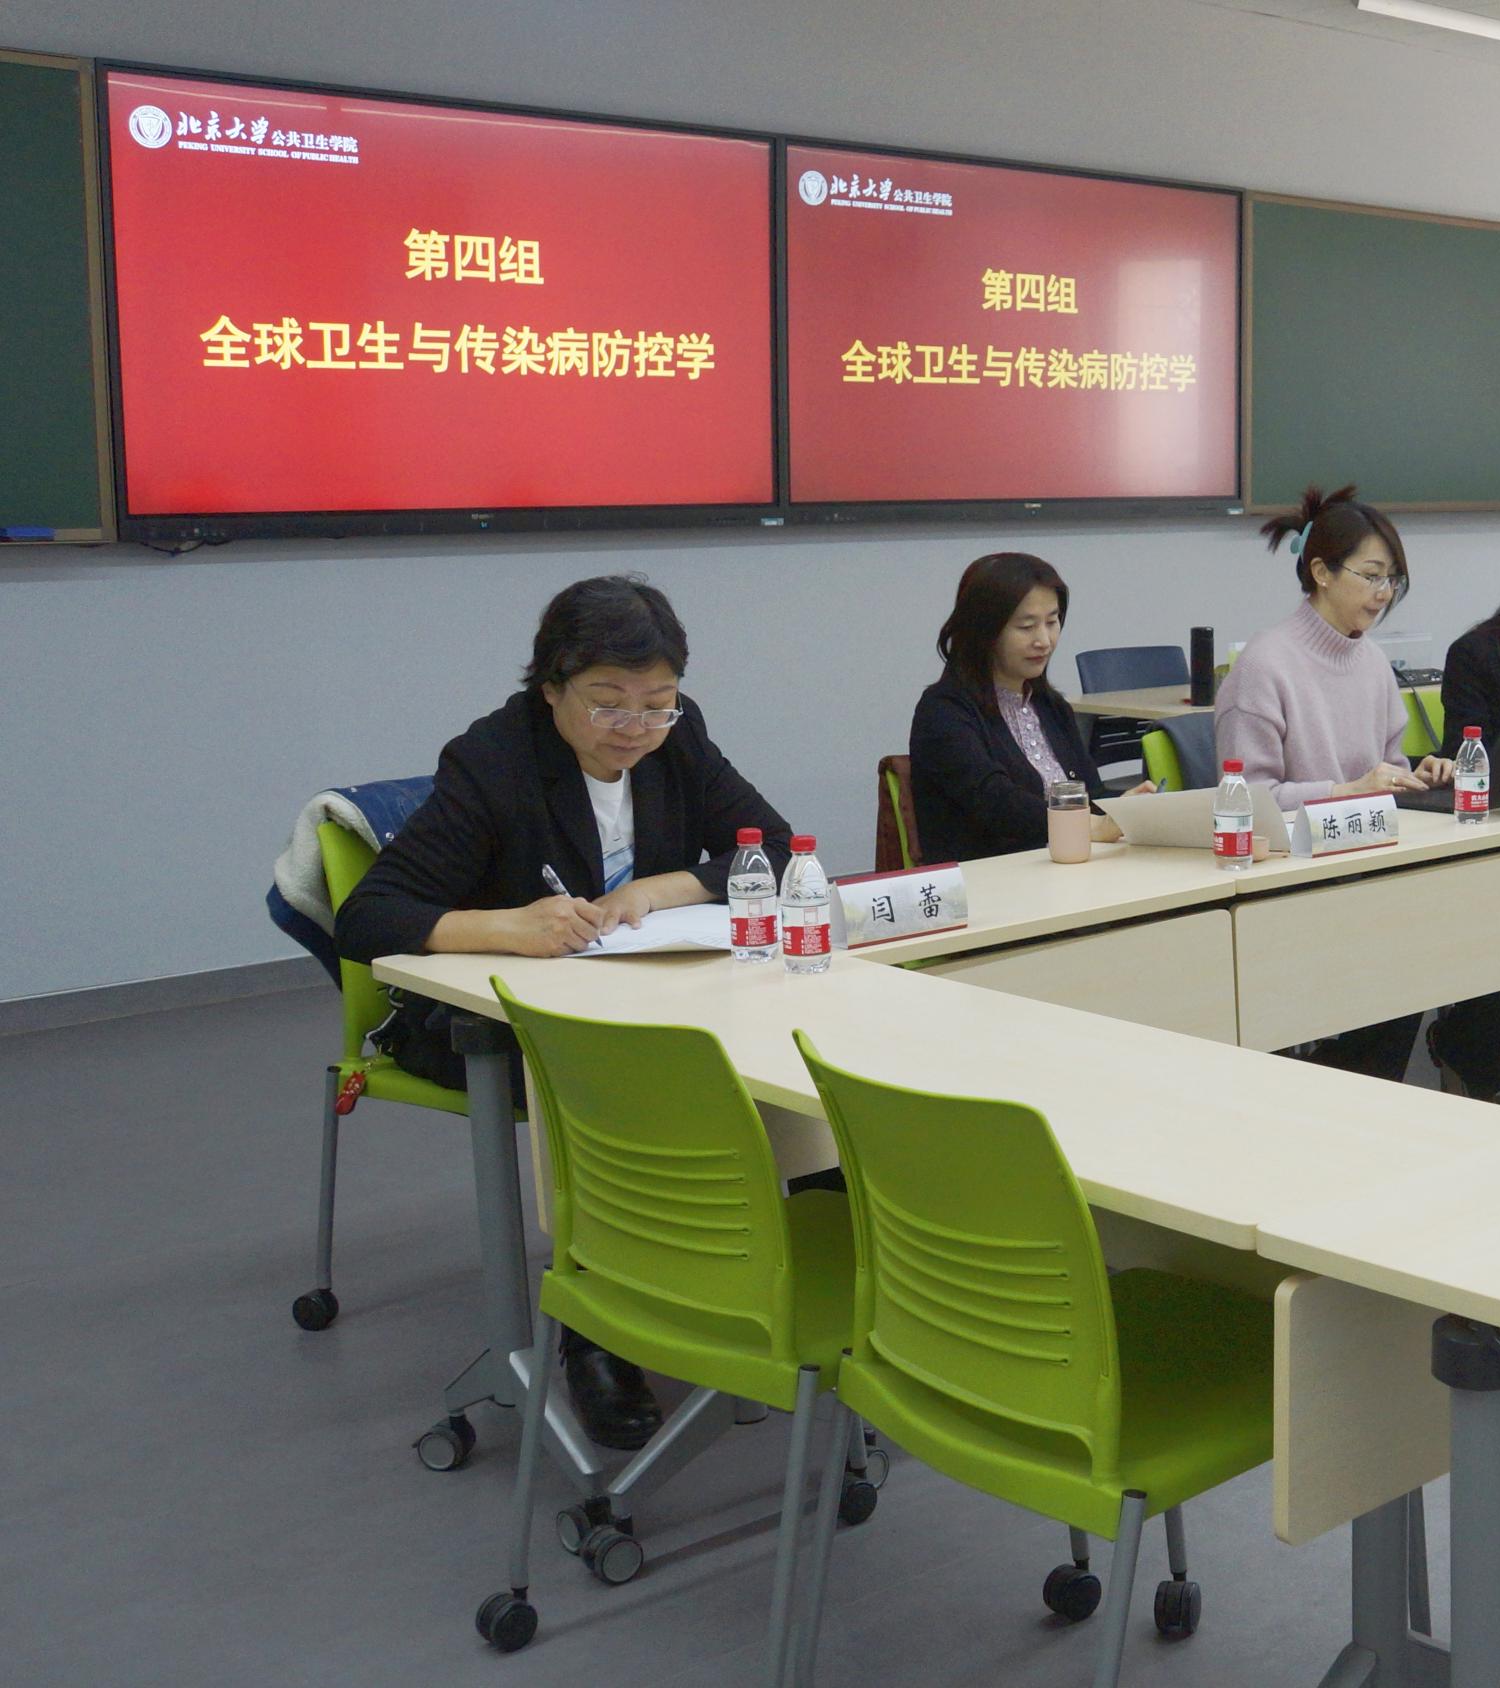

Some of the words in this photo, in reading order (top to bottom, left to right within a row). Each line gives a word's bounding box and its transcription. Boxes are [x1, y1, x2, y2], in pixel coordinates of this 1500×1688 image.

[176, 111, 269, 145] 北京大学
[271, 129, 359, 154] 公共卫生学院
[178, 141, 208, 151] PEKING
[210, 143, 256, 156] UNIVERSITY
[258, 147, 289, 159] SCHOOL
[291, 151, 302, 160] OF
[302, 151, 329, 162] PUBLIC
[329, 153, 359, 165] HEALTH
[830, 174, 893, 201] 北京大学
[893, 188, 953, 207] 公共卫生学院
[403, 227, 544, 285] 第四组
[981, 267, 1078, 314] 第四组
[199, 313, 716, 380] 全球卫生与传染病防控学
[841, 339, 1197, 393] 全球卫生与传染病防控学
[1322, 809, 1386, 840] 陈丽颖
[872, 883, 942, 923] 闫蕾
